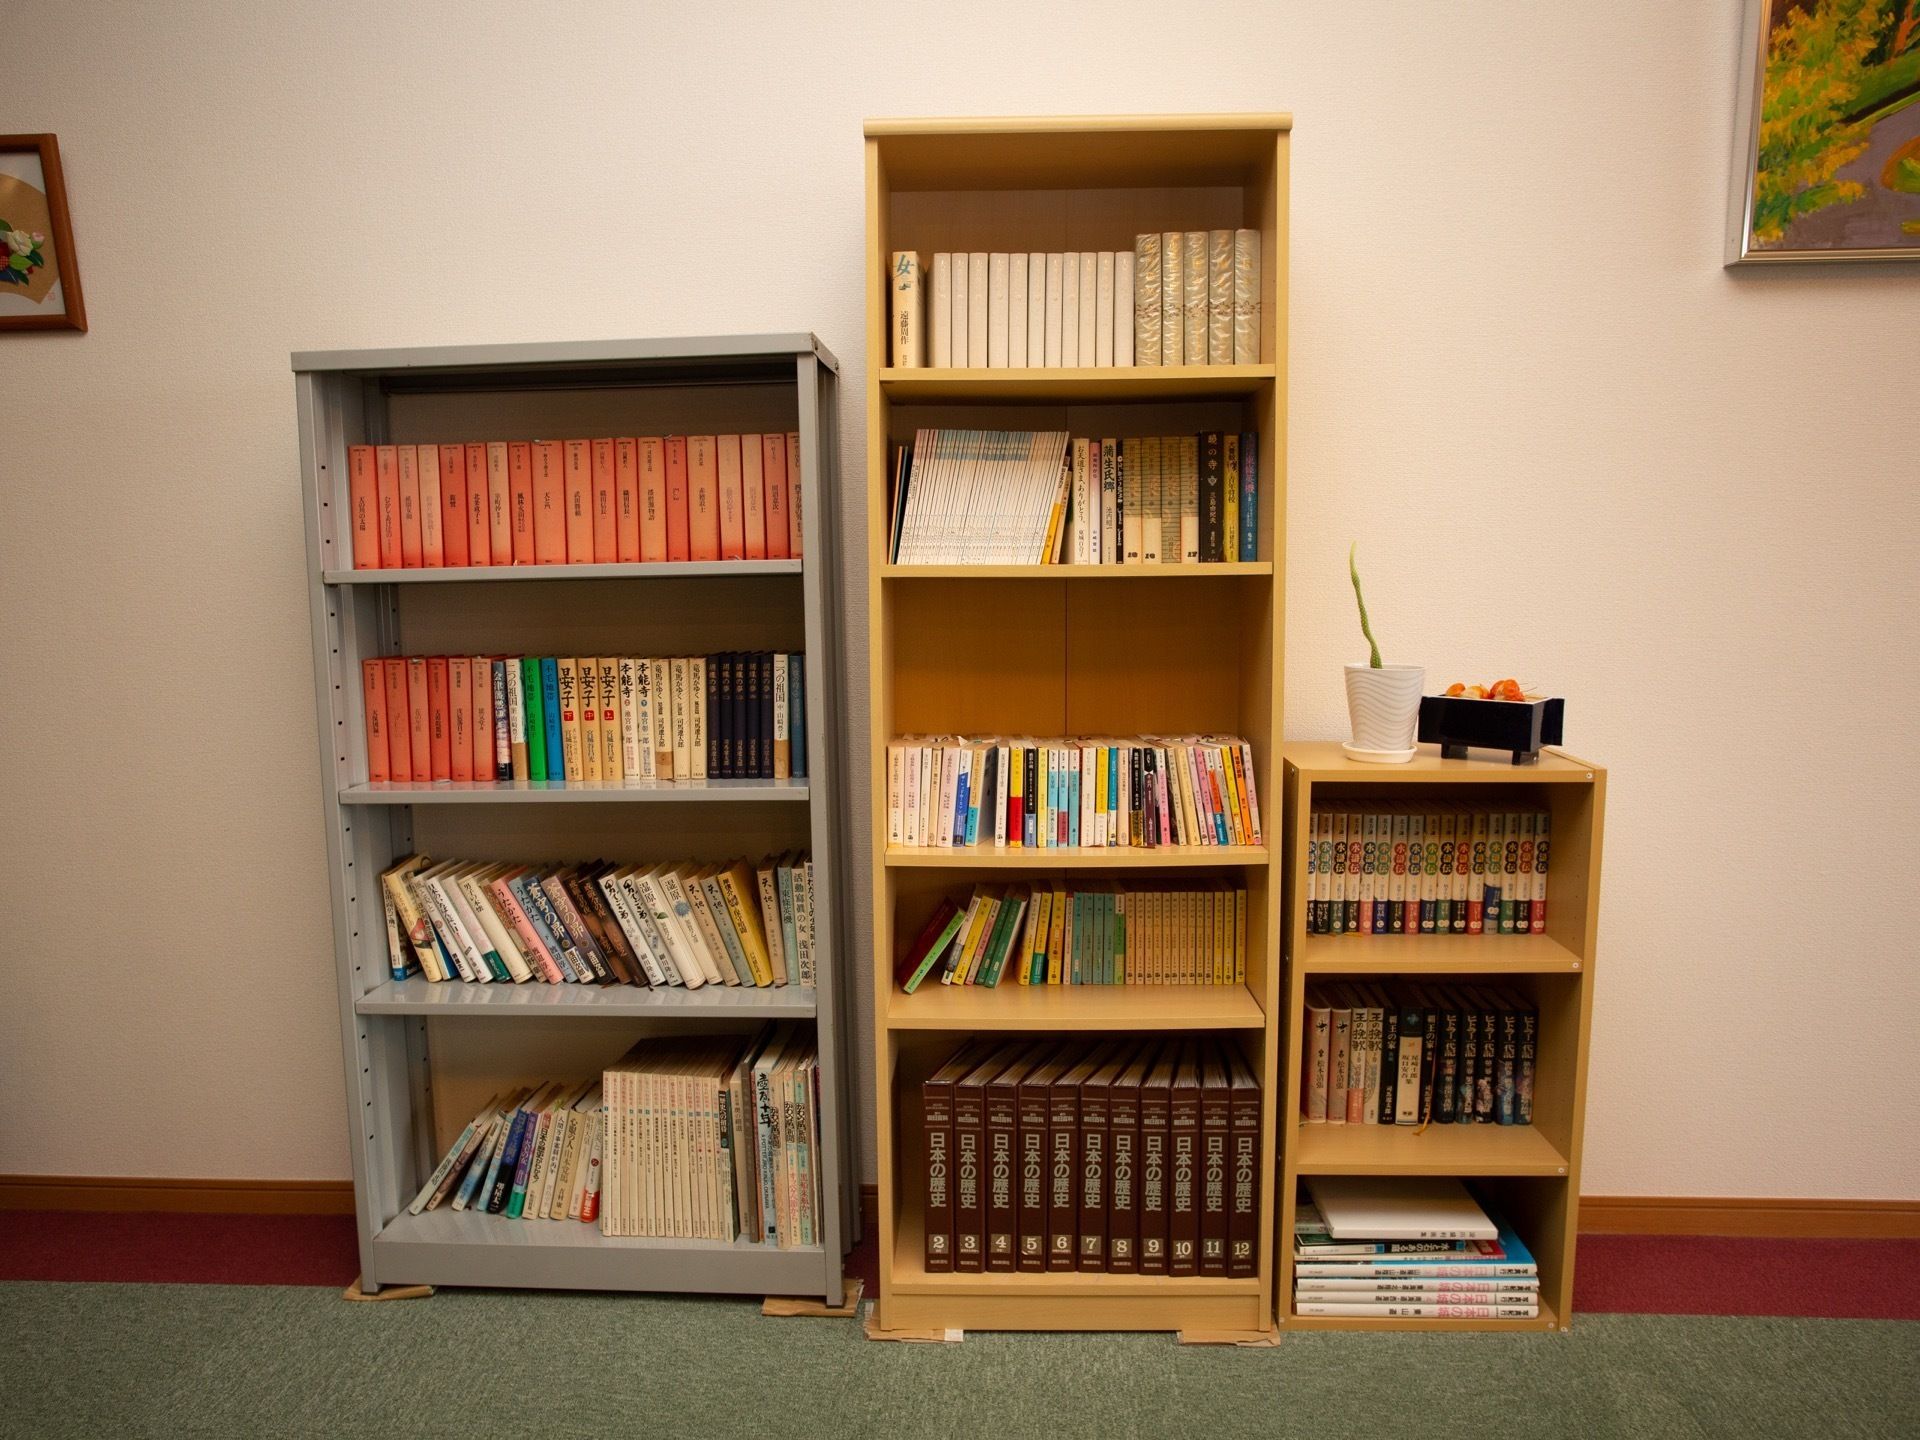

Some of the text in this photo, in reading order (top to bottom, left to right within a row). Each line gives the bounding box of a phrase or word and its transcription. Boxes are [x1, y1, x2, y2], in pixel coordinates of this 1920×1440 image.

[896, 254, 914, 278] 女
[900, 310, 909, 345] 遠藤周作
[1104, 445, 1115, 492] 蒲生氏郷
[508, 664, 518, 706] 二つの祖国
[560, 668, 574, 708] 晏子
[580, 667, 596, 708] 晏子
[600, 666, 616, 708] 晏子
[620, 663, 634, 698] 本能寺
[637, 662, 650, 698] 本能寺
[776, 660, 784, 703] 二つの祖国
[639, 881, 657, 902] 湿原
[665, 880, 682, 900] 湿原
[799, 940, 811, 980] 浅田次郎
[1352, 1012, 1366, 1052] 王の挽歌
[1368, 1012, 1382, 1052] 王の挽歌
[930, 1132, 946, 1208] 日本の歴史
[960, 1134, 977, 1209] 日本の歴史
[993, 1134, 1010, 1209] 日本の歴史
[1024, 1134, 1040, 1209] 日本の歴史
[1054, 1133, 1070, 1208] 日本の歴史
[1085, 1134, 1102, 1209] 日本の歴史
[1115, 1135, 1132, 1210] 日本の歴史
[1145, 1136, 1162, 1211] 日本の歴史
[1175, 1137, 1192, 1212] 日本の歴史
[1206, 1137, 1223, 1212] 日本の歴史
[1235, 1137, 1252, 1213] 日本の歴史
[933, 1236, 944, 1249] 2
[964, 1236, 976, 1249] 3
[995, 1236, 1006, 1248] 4
[1026, 1238, 1037, 1250] 5
[1057, 1236, 1067, 1249] 6
[1086, 1237, 1097, 1250] 7
[1117, 1240, 1128, 1252] 8
[1148, 1240, 1159, 1252] 9
[1175, 1242, 1191, 1254] 10
[1206, 1241, 1221, 1253] 11
[1234, 1242, 1250, 1255] 12
[1436, 1266, 1488, 1277] 日本の城
[1438, 1282, 1490, 1292] 日本の城
[1436, 1293, 1488, 1304] 日本の城
[1438, 1306, 1490, 1318] 日本の城
